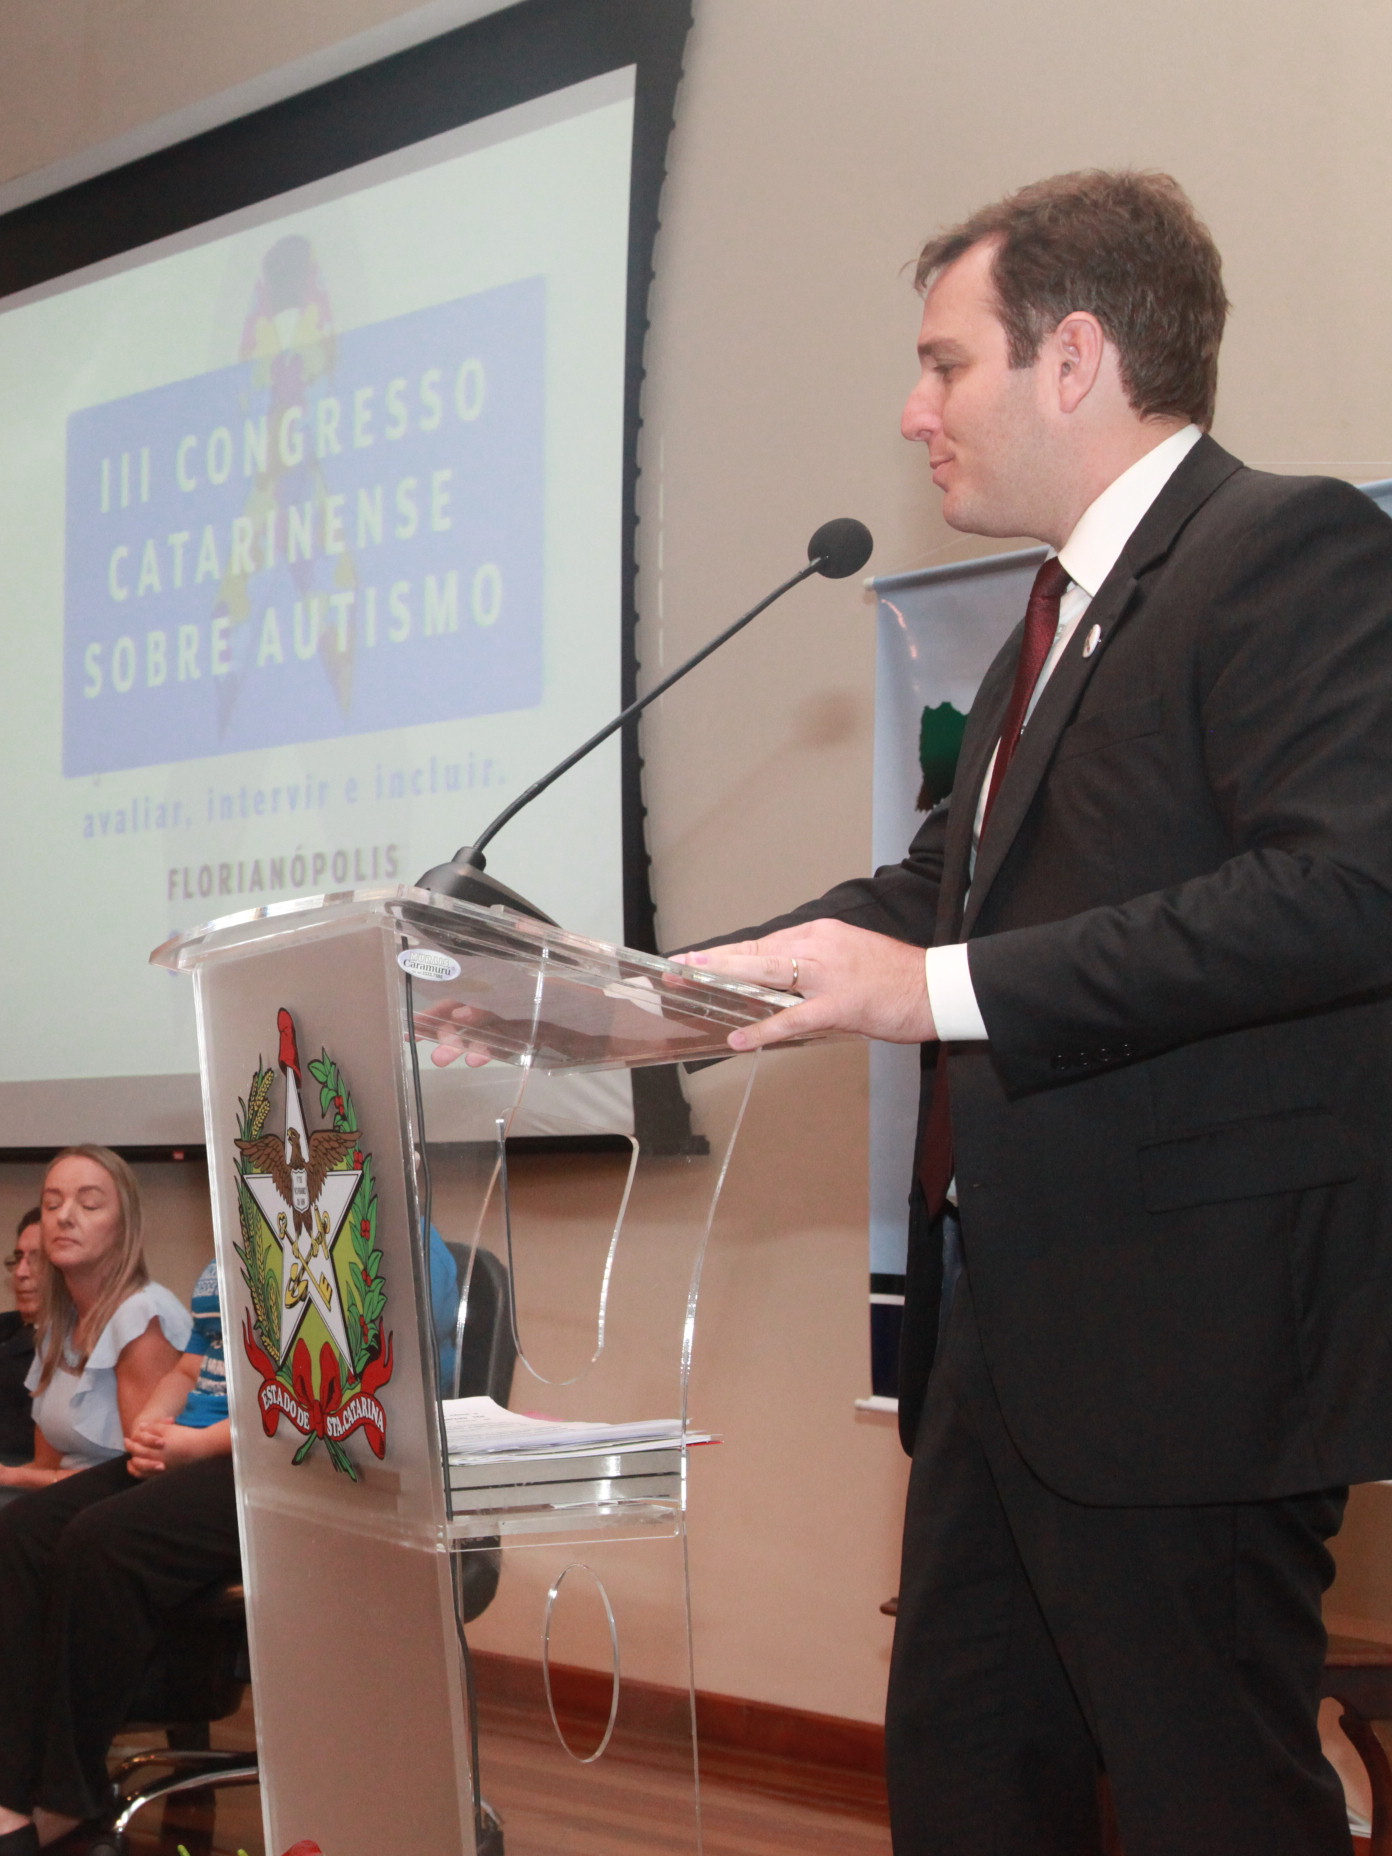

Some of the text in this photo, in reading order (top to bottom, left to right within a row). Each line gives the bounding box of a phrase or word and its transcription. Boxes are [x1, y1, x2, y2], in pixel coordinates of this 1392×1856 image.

[100, 357, 487, 514] III CONGRESSO
[108, 467, 454, 602] CATARINENSE
[83, 562, 504, 699] SOBRE AUTISMO
[83, 751, 507, 839] avaliar, intervir e incluir.
[167, 843, 401, 901] FLORIANÓPOLIS
[261, 1384, 297, 1418] ESTADO
[296, 1408, 310, 1430] DE
